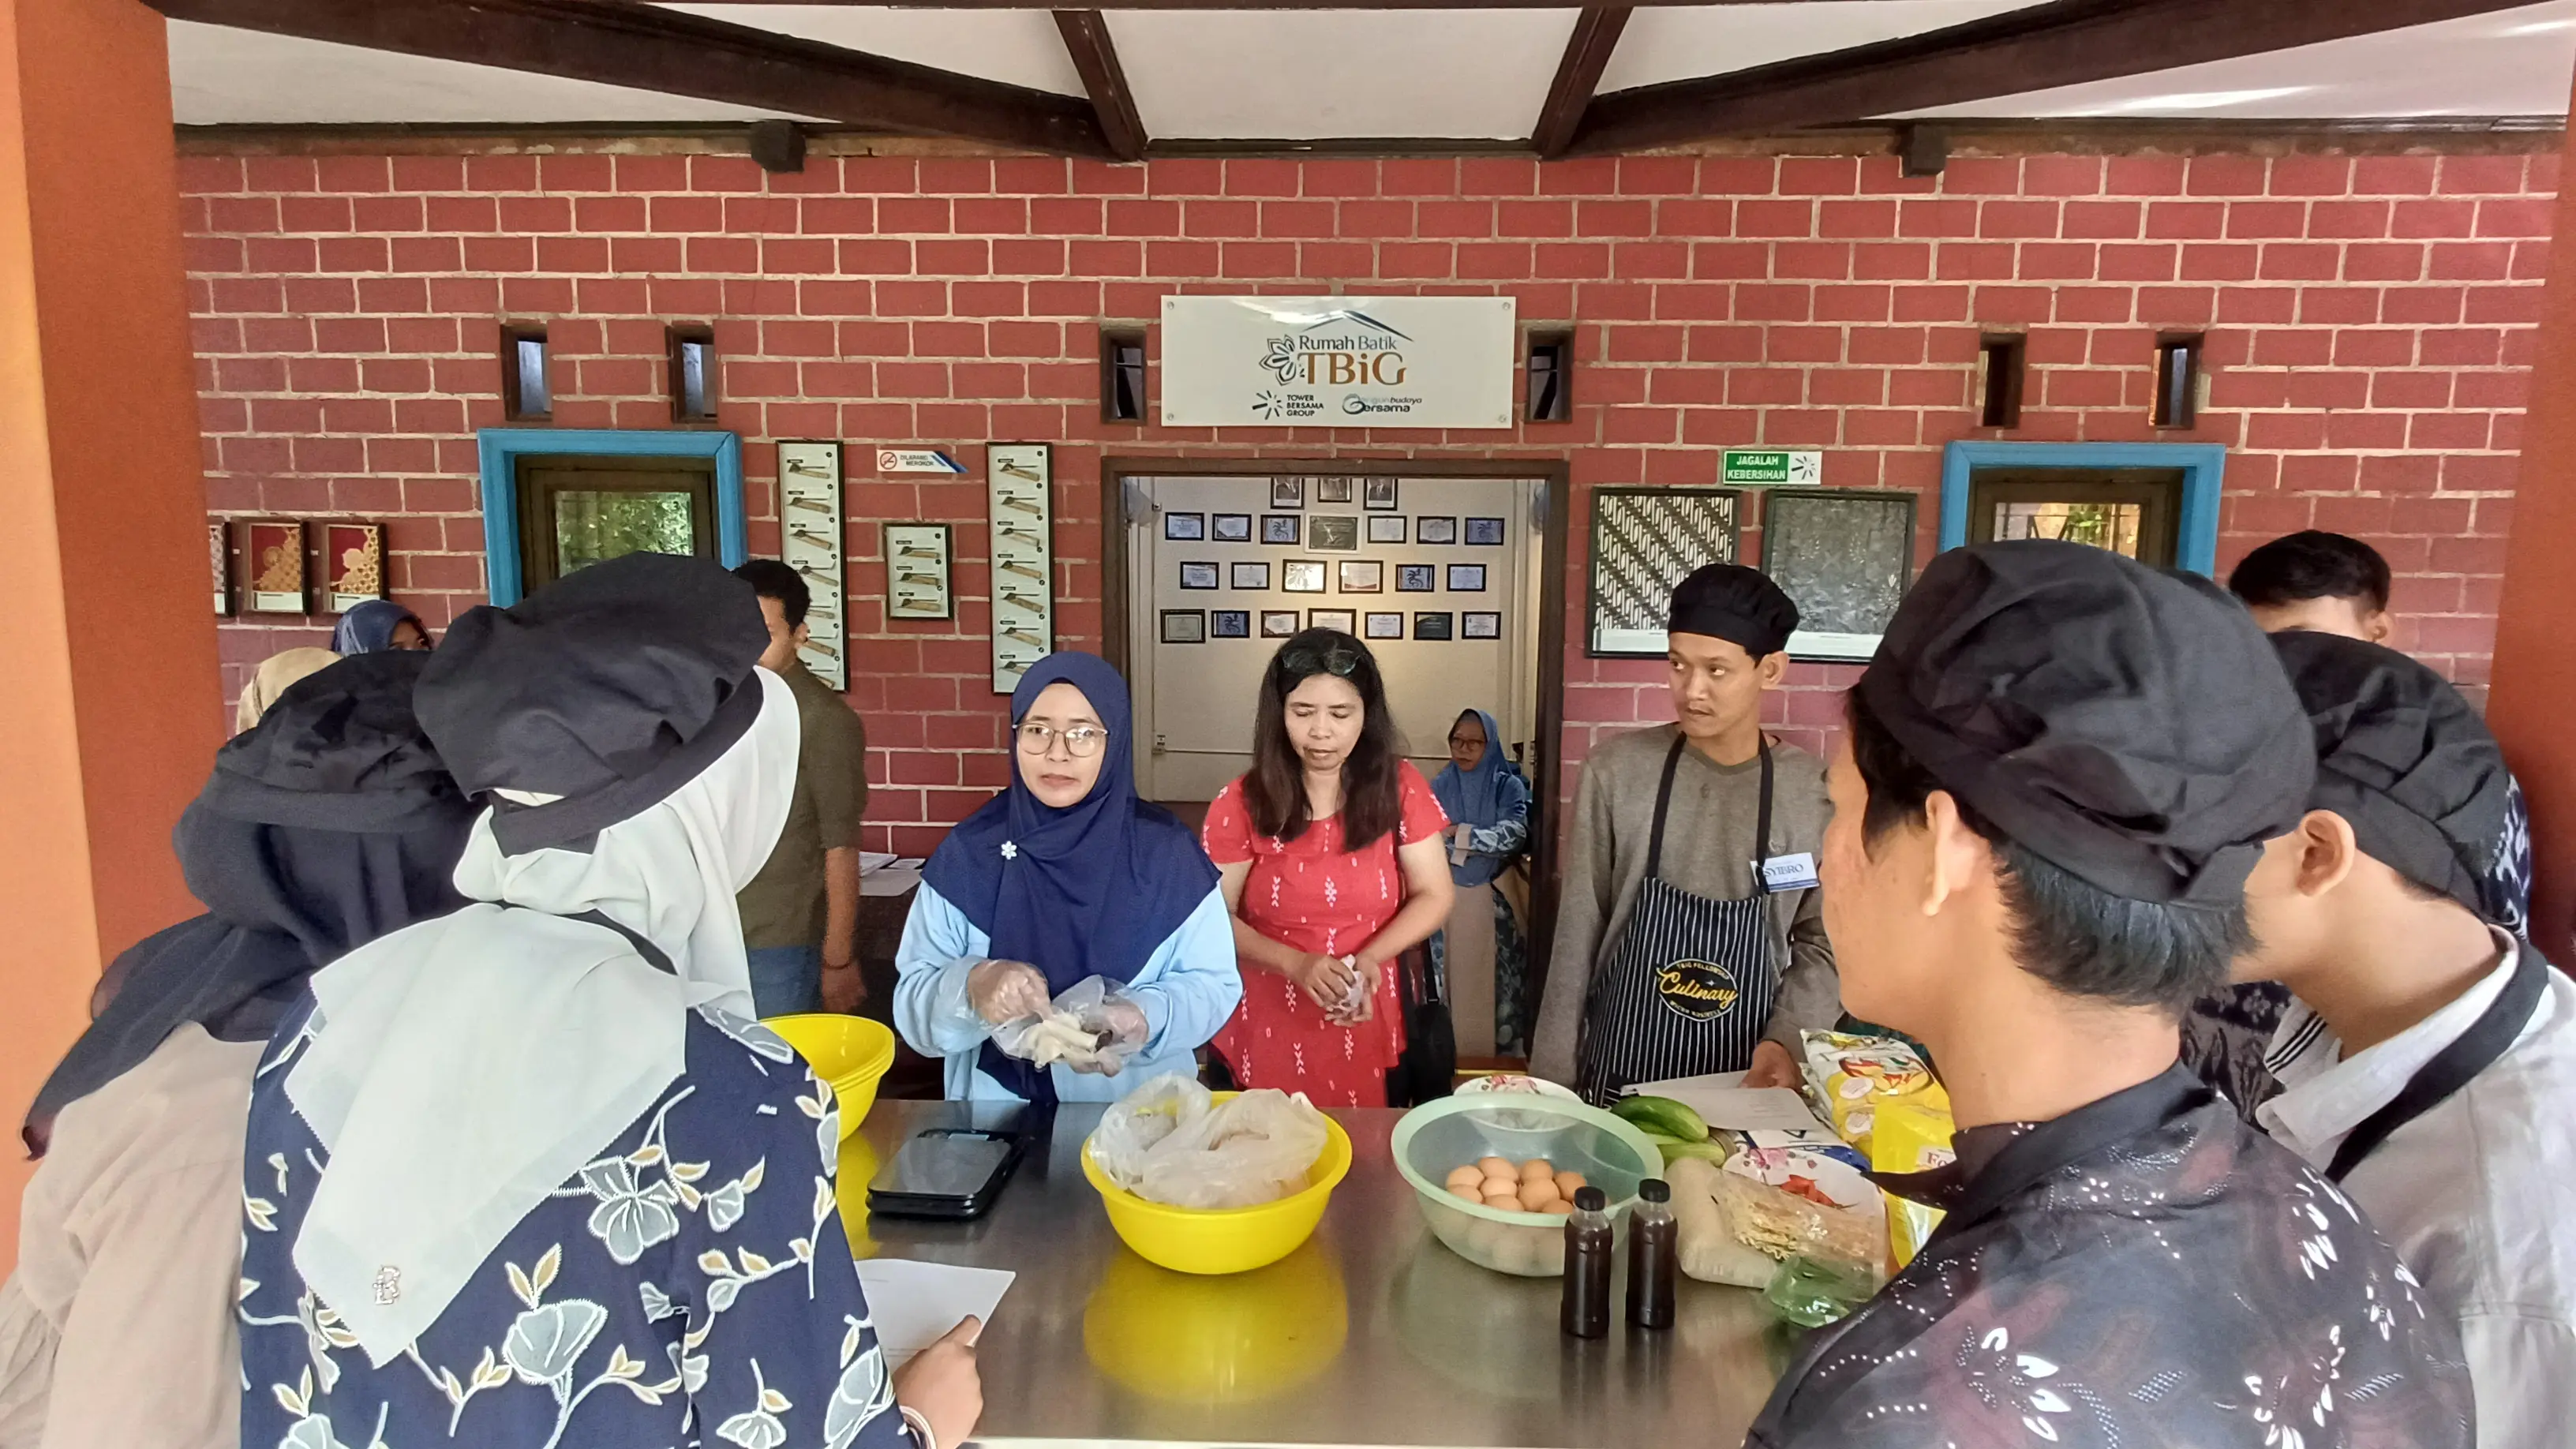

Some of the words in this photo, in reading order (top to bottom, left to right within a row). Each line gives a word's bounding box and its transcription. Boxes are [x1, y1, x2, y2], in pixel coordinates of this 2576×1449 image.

[1299, 335, 1354, 350] Rumah
[1358, 335, 1398, 350] Batik
[1297, 351, 1407, 385] TBiG
[1736, 455, 1779, 466] JAGALAH
[1727, 470, 1786, 480] KEBERSIHAN
[1656, 967, 1739, 1009] Culinary
